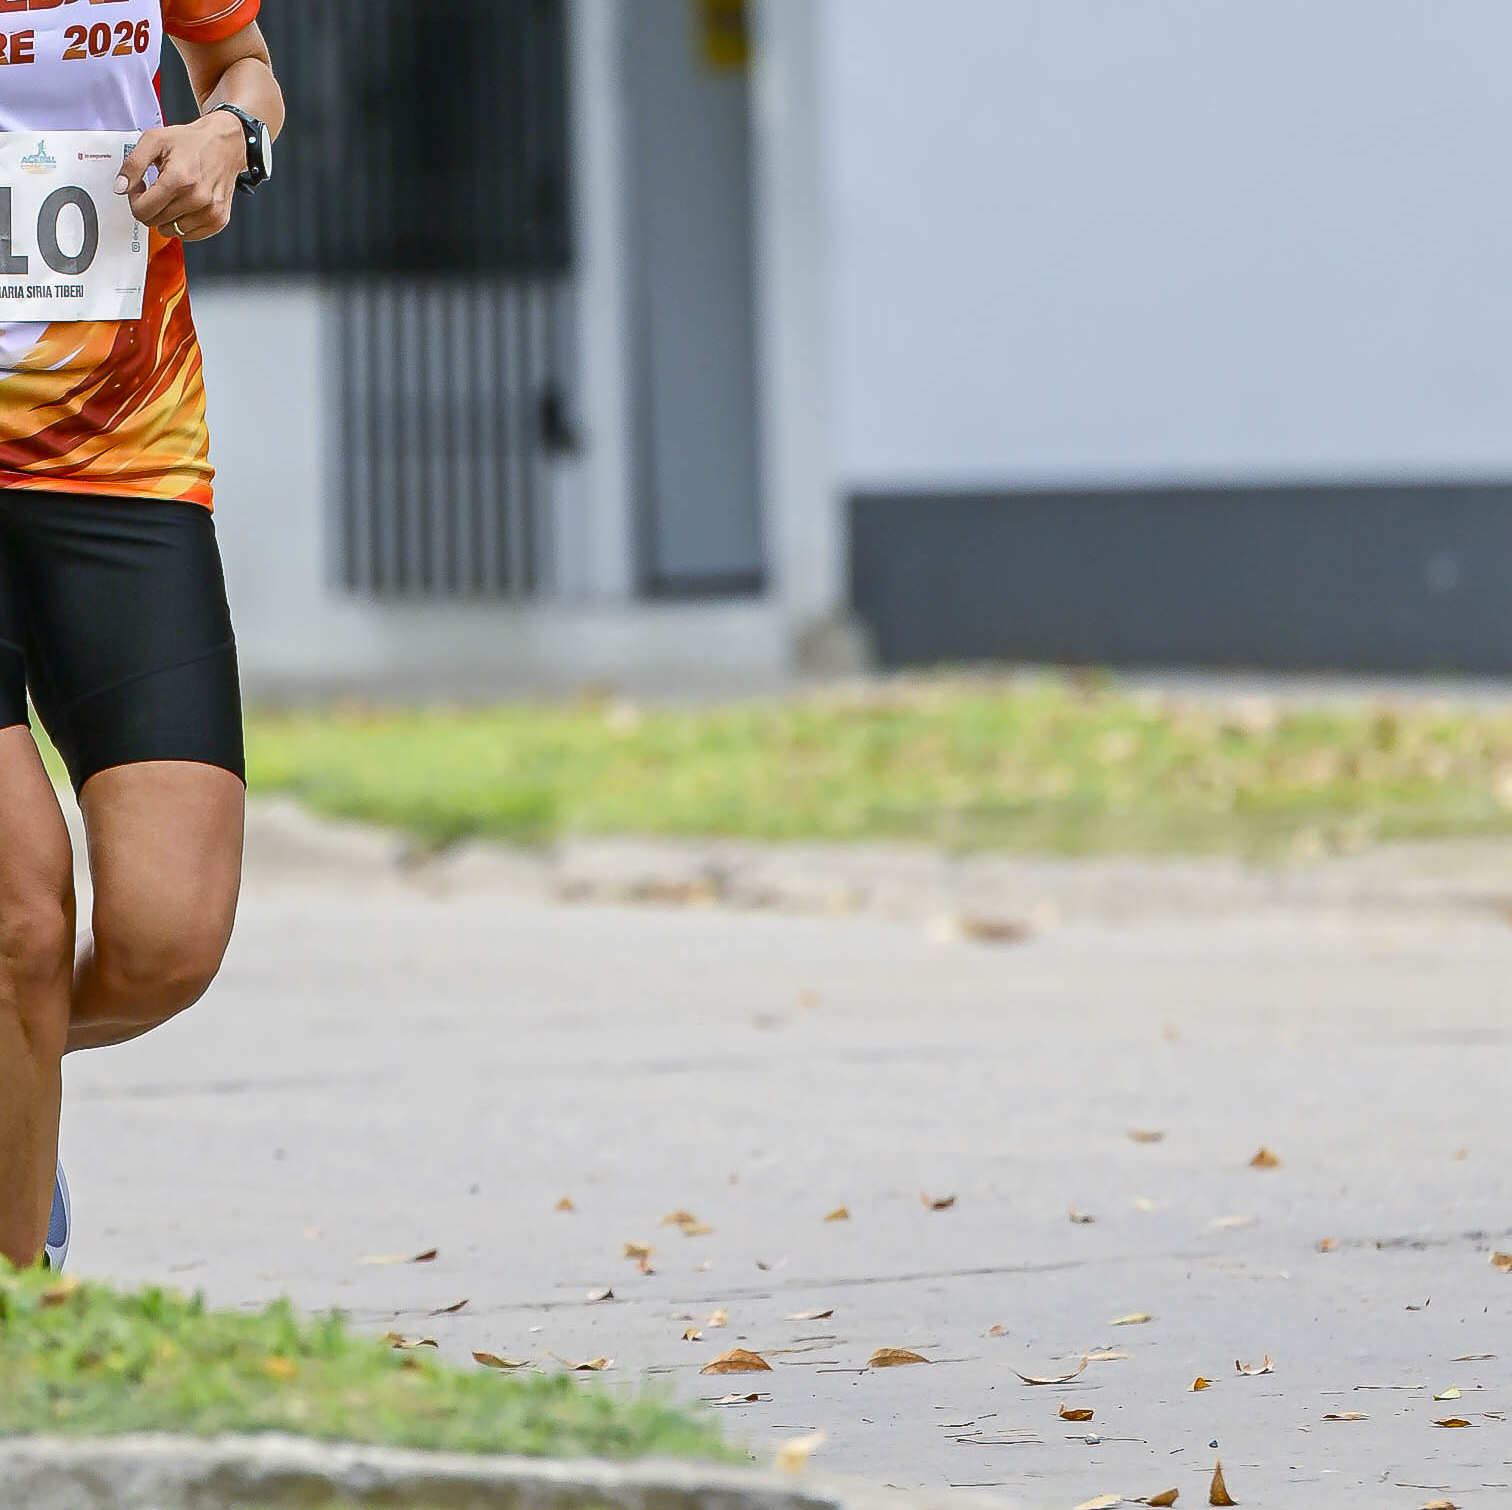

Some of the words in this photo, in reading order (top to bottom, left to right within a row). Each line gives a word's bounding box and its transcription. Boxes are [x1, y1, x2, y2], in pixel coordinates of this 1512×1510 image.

[62, 19, 149, 61] 2026
[26, 285, 52, 298] SIRIA
[54, 285, 84, 298] TIBERI
